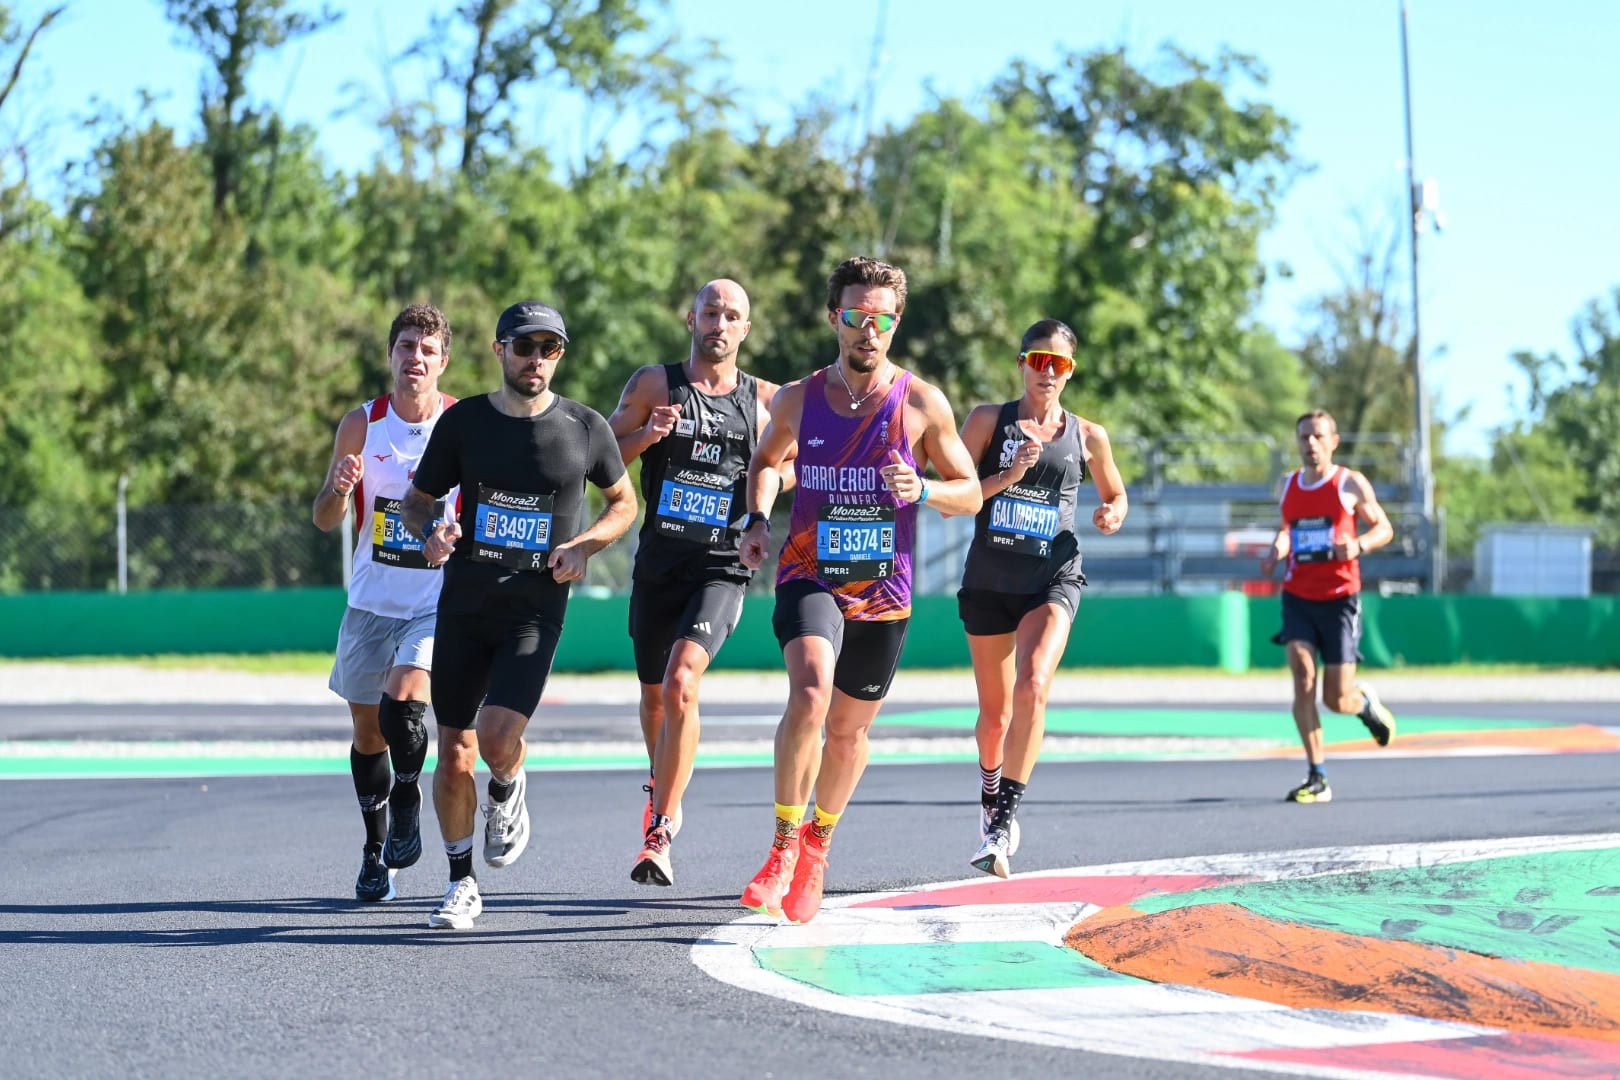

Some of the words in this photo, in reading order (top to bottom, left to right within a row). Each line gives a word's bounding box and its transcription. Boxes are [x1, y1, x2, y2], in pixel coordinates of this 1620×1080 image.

[677, 469, 722, 485] Monza21
[839, 467, 876, 492] ERGO
[490, 491, 540, 506] Monza21
[829, 493, 878, 505] RUNNERS
[1006, 484, 1051, 500] Monza21
[683, 491, 717, 516] 3215
[830, 506, 881, 516] Monza21
[498, 514, 537, 540] 3497
[992, 500, 1057, 537] GALIMBERTI
[843, 528, 879, 552] 3374
